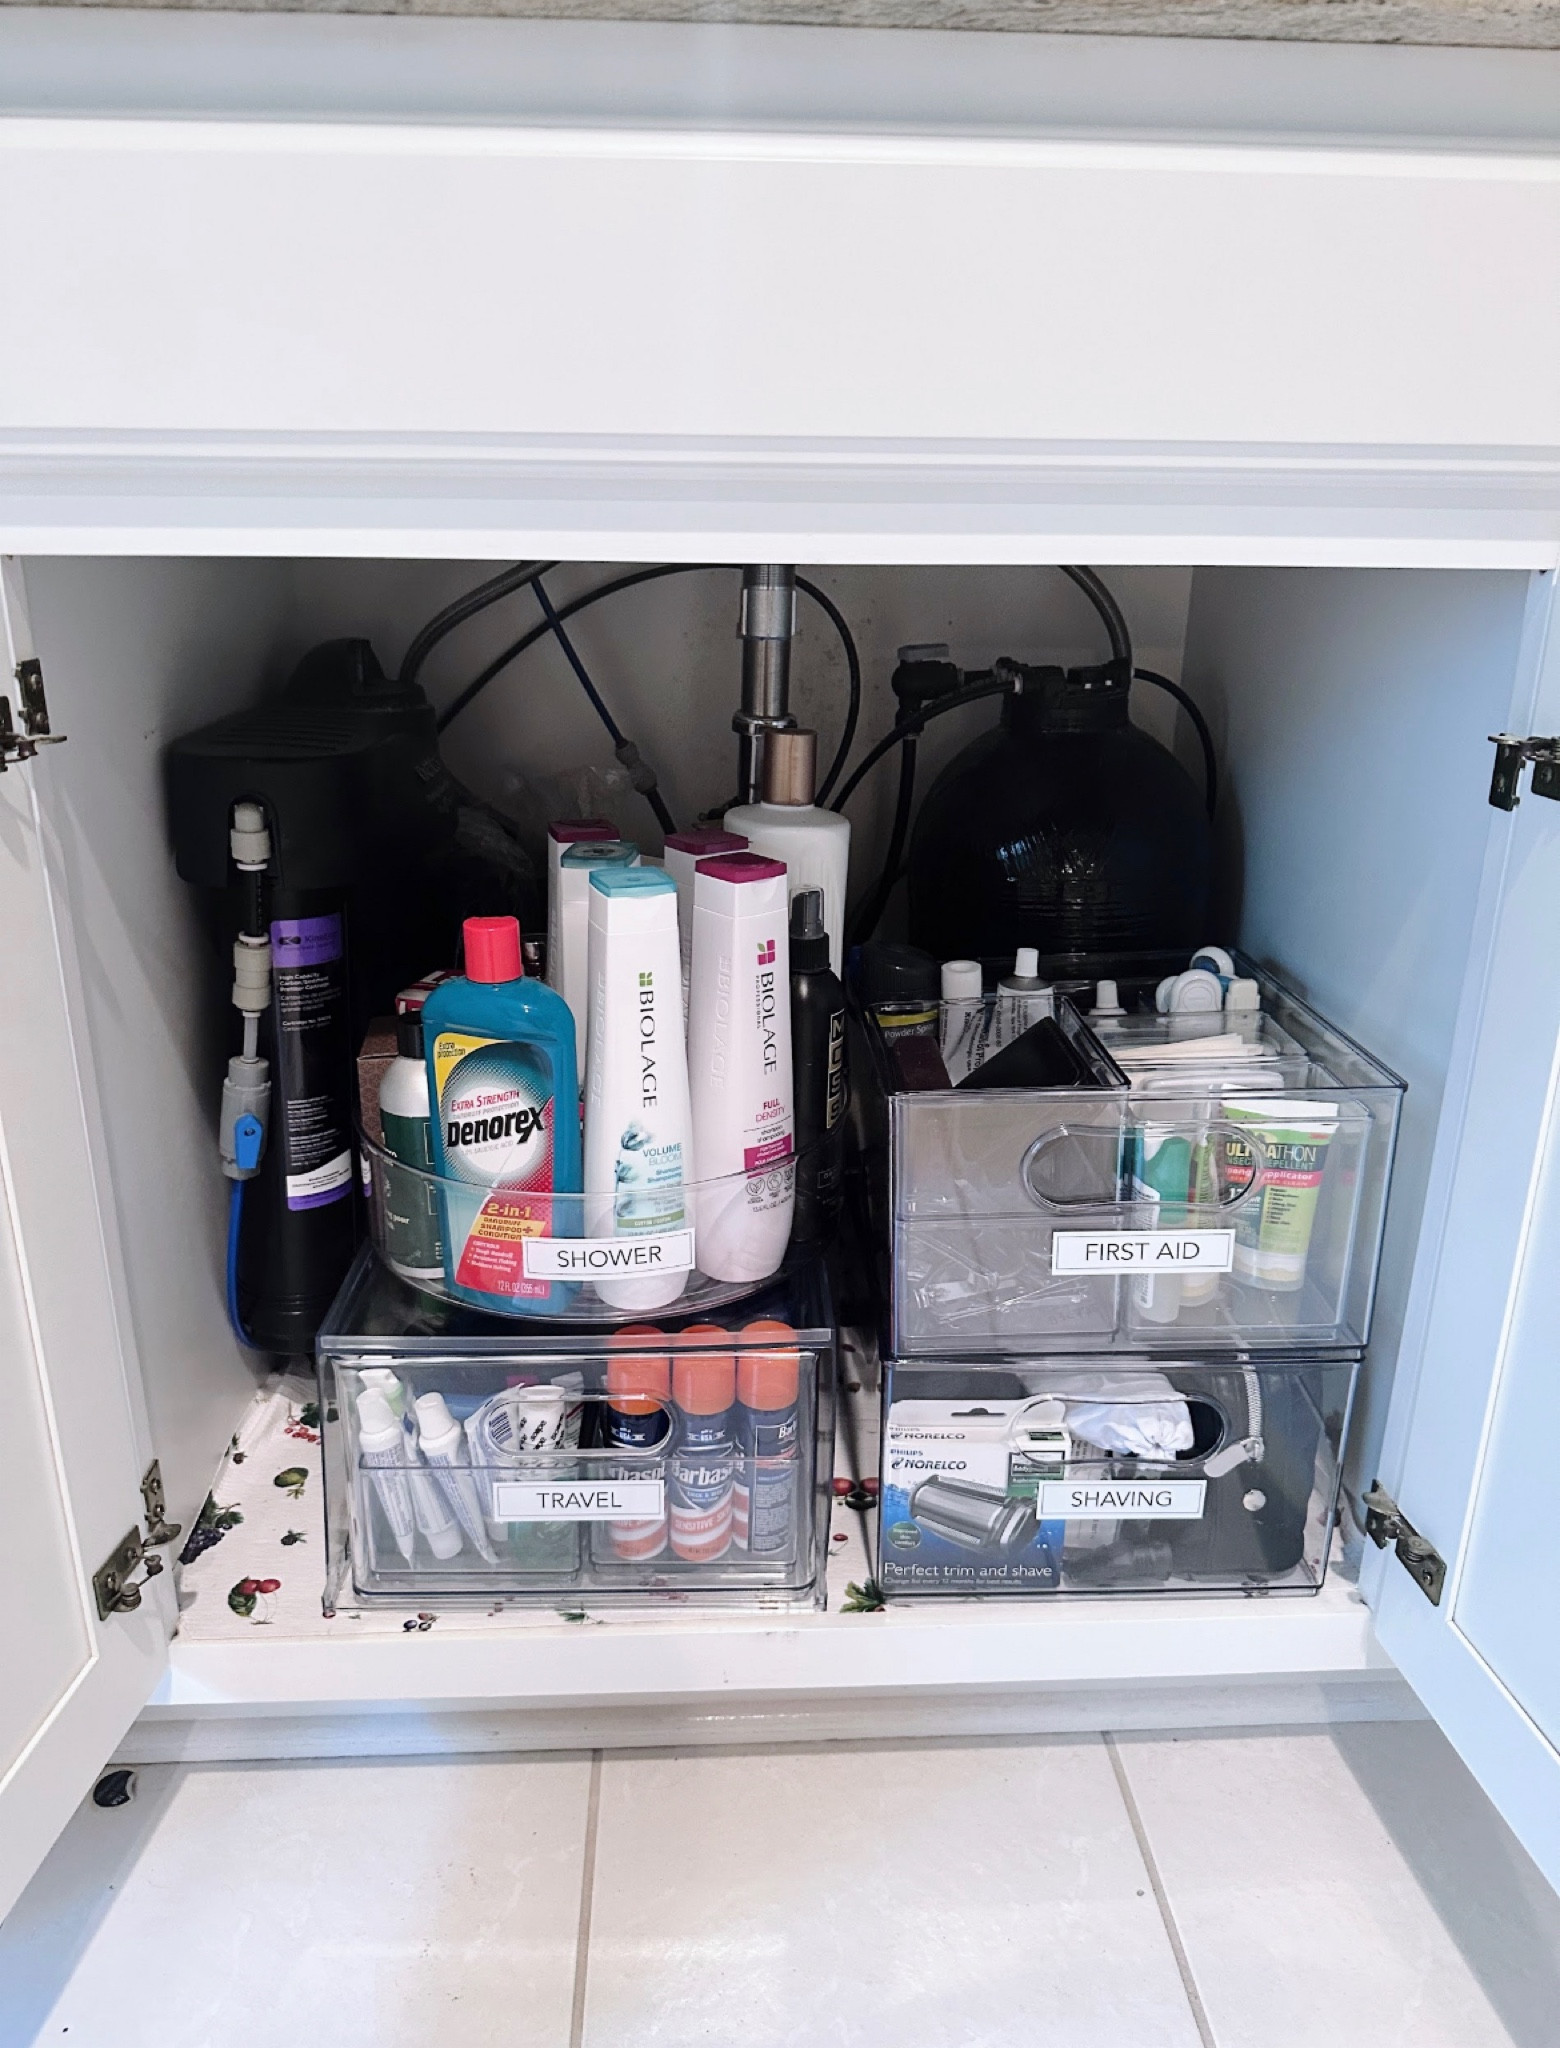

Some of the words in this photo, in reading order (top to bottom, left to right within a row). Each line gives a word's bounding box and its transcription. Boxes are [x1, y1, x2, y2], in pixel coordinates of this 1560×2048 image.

[760, 971, 777, 1076] BIOLAGE
[884, 1028, 914, 1039] Powder
[639, 990, 658, 1108] BIOLAGE
[451, 1099, 474, 1112] EXTRA
[476, 1090, 520, 1108] STRENGTH
[763, 1098, 780, 1110] FULL
[755, 1106, 785, 1122] DENSITY
[447, 1107, 544, 1147] Denorex
[643, 1142, 681, 1157] VOLUME
[1226, 1142, 1317, 1162] ULTATHON
[1266, 1160, 1314, 1171] EPELLENT
[1264, 1170, 1314, 1181] pplicator
[487, 1203, 532, 1218] 2-in-1
[478, 1229, 522, 1240] CONDITION
[557, 1245, 662, 1268] SHOWER
[1085, 1243, 1150, 1261] FIRST
[1156, 1242, 1200, 1260] AID
[904, 1432, 966, 1440] NORELCO
[904, 1459, 967, 1470] NORELCO
[536, 1491, 622, 1509] TRAVEL
[1071, 1491, 1172, 1508] SHAVING
[675, 1517, 715, 1531] SENSITIVE
[884, 1562, 939, 1576] Perfect
[944, 1564, 975, 1576] trim
[980, 1564, 1008, 1576] and
[1012, 1563, 1052, 1577] shave
